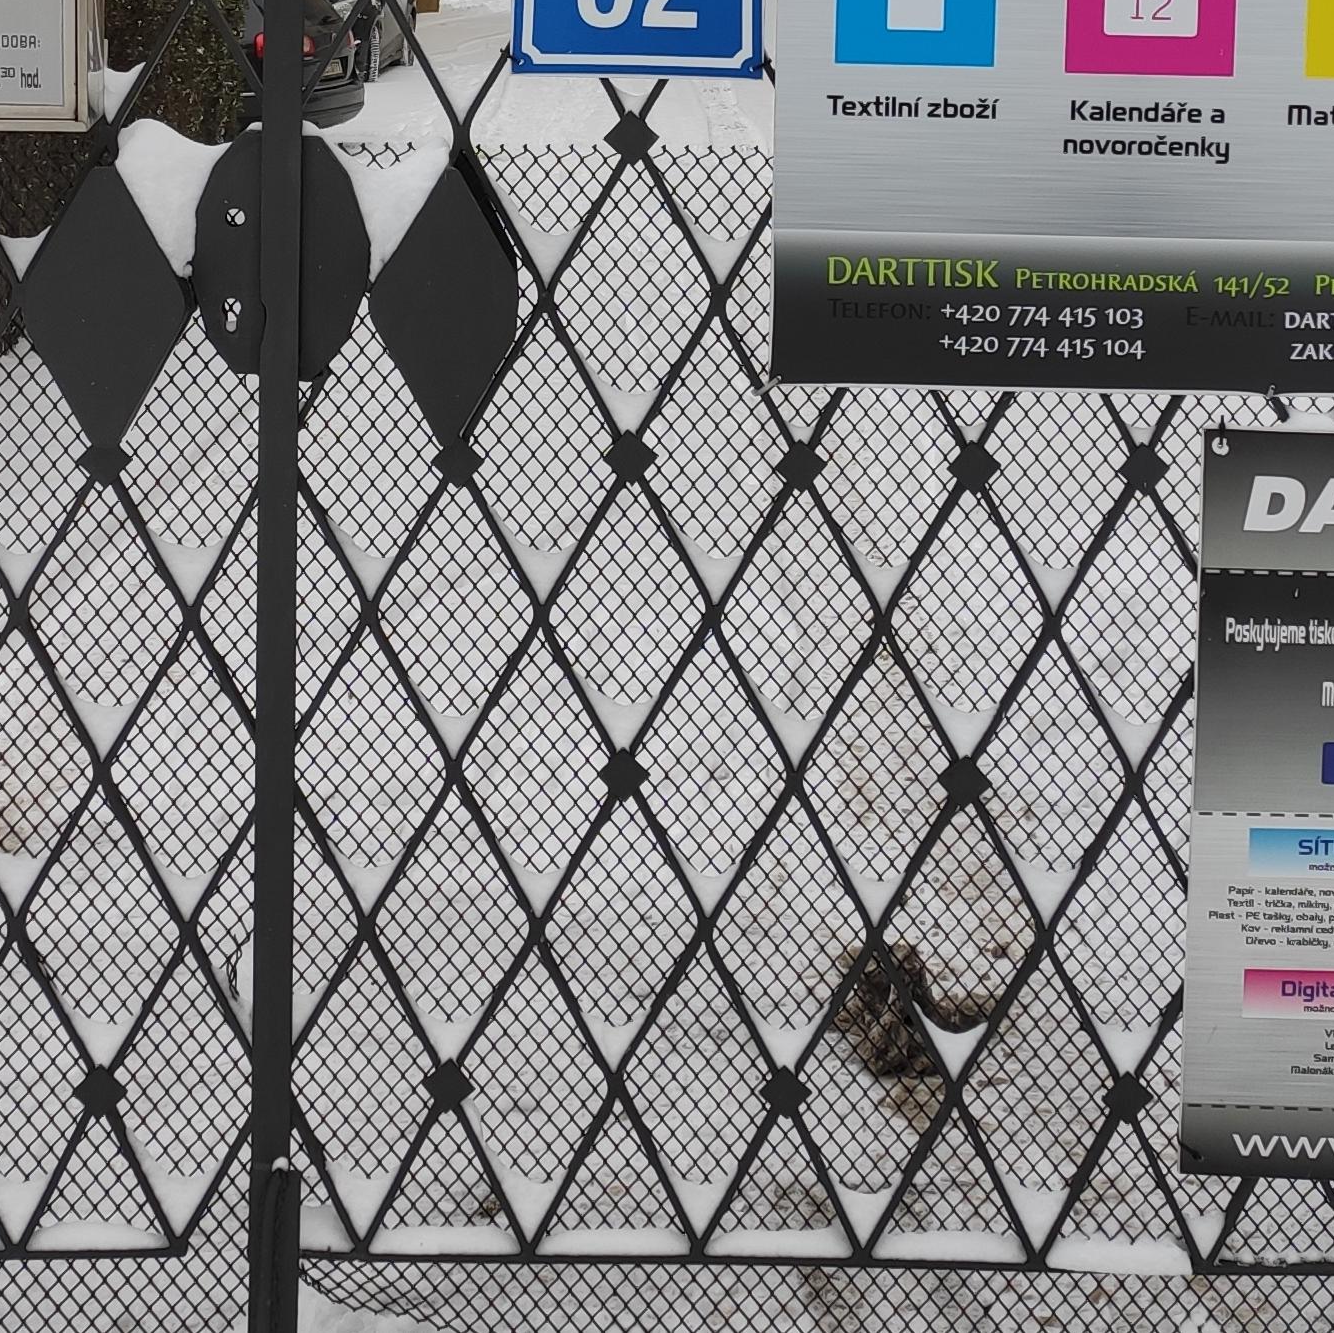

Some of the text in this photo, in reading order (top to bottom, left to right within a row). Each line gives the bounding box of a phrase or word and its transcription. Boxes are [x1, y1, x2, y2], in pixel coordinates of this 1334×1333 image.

[2, 35, 40, 48] DOBA:
[21, 67, 41, 88] hod.
[826, 94, 998, 121] Textilní zboží
[1070, 100, 1225, 125] Kalendáře a
[1063, 134, 1230, 165] novoročenky
[827, 256, 999, 289] DARTTISK
[1213, 272, 1290, 299] 141/52
[941, 304, 1000, 325] +420
[1008, 306, 1051, 327] 774
[1058, 307, 1097, 328] 415
[1104, 308, 1144, 328] 103
[939, 335, 1146, 359] +420 774 415 104
[1225, 617, 1305, 652] Poskytujeme
[1228, 886, 1255, 897] Papír
